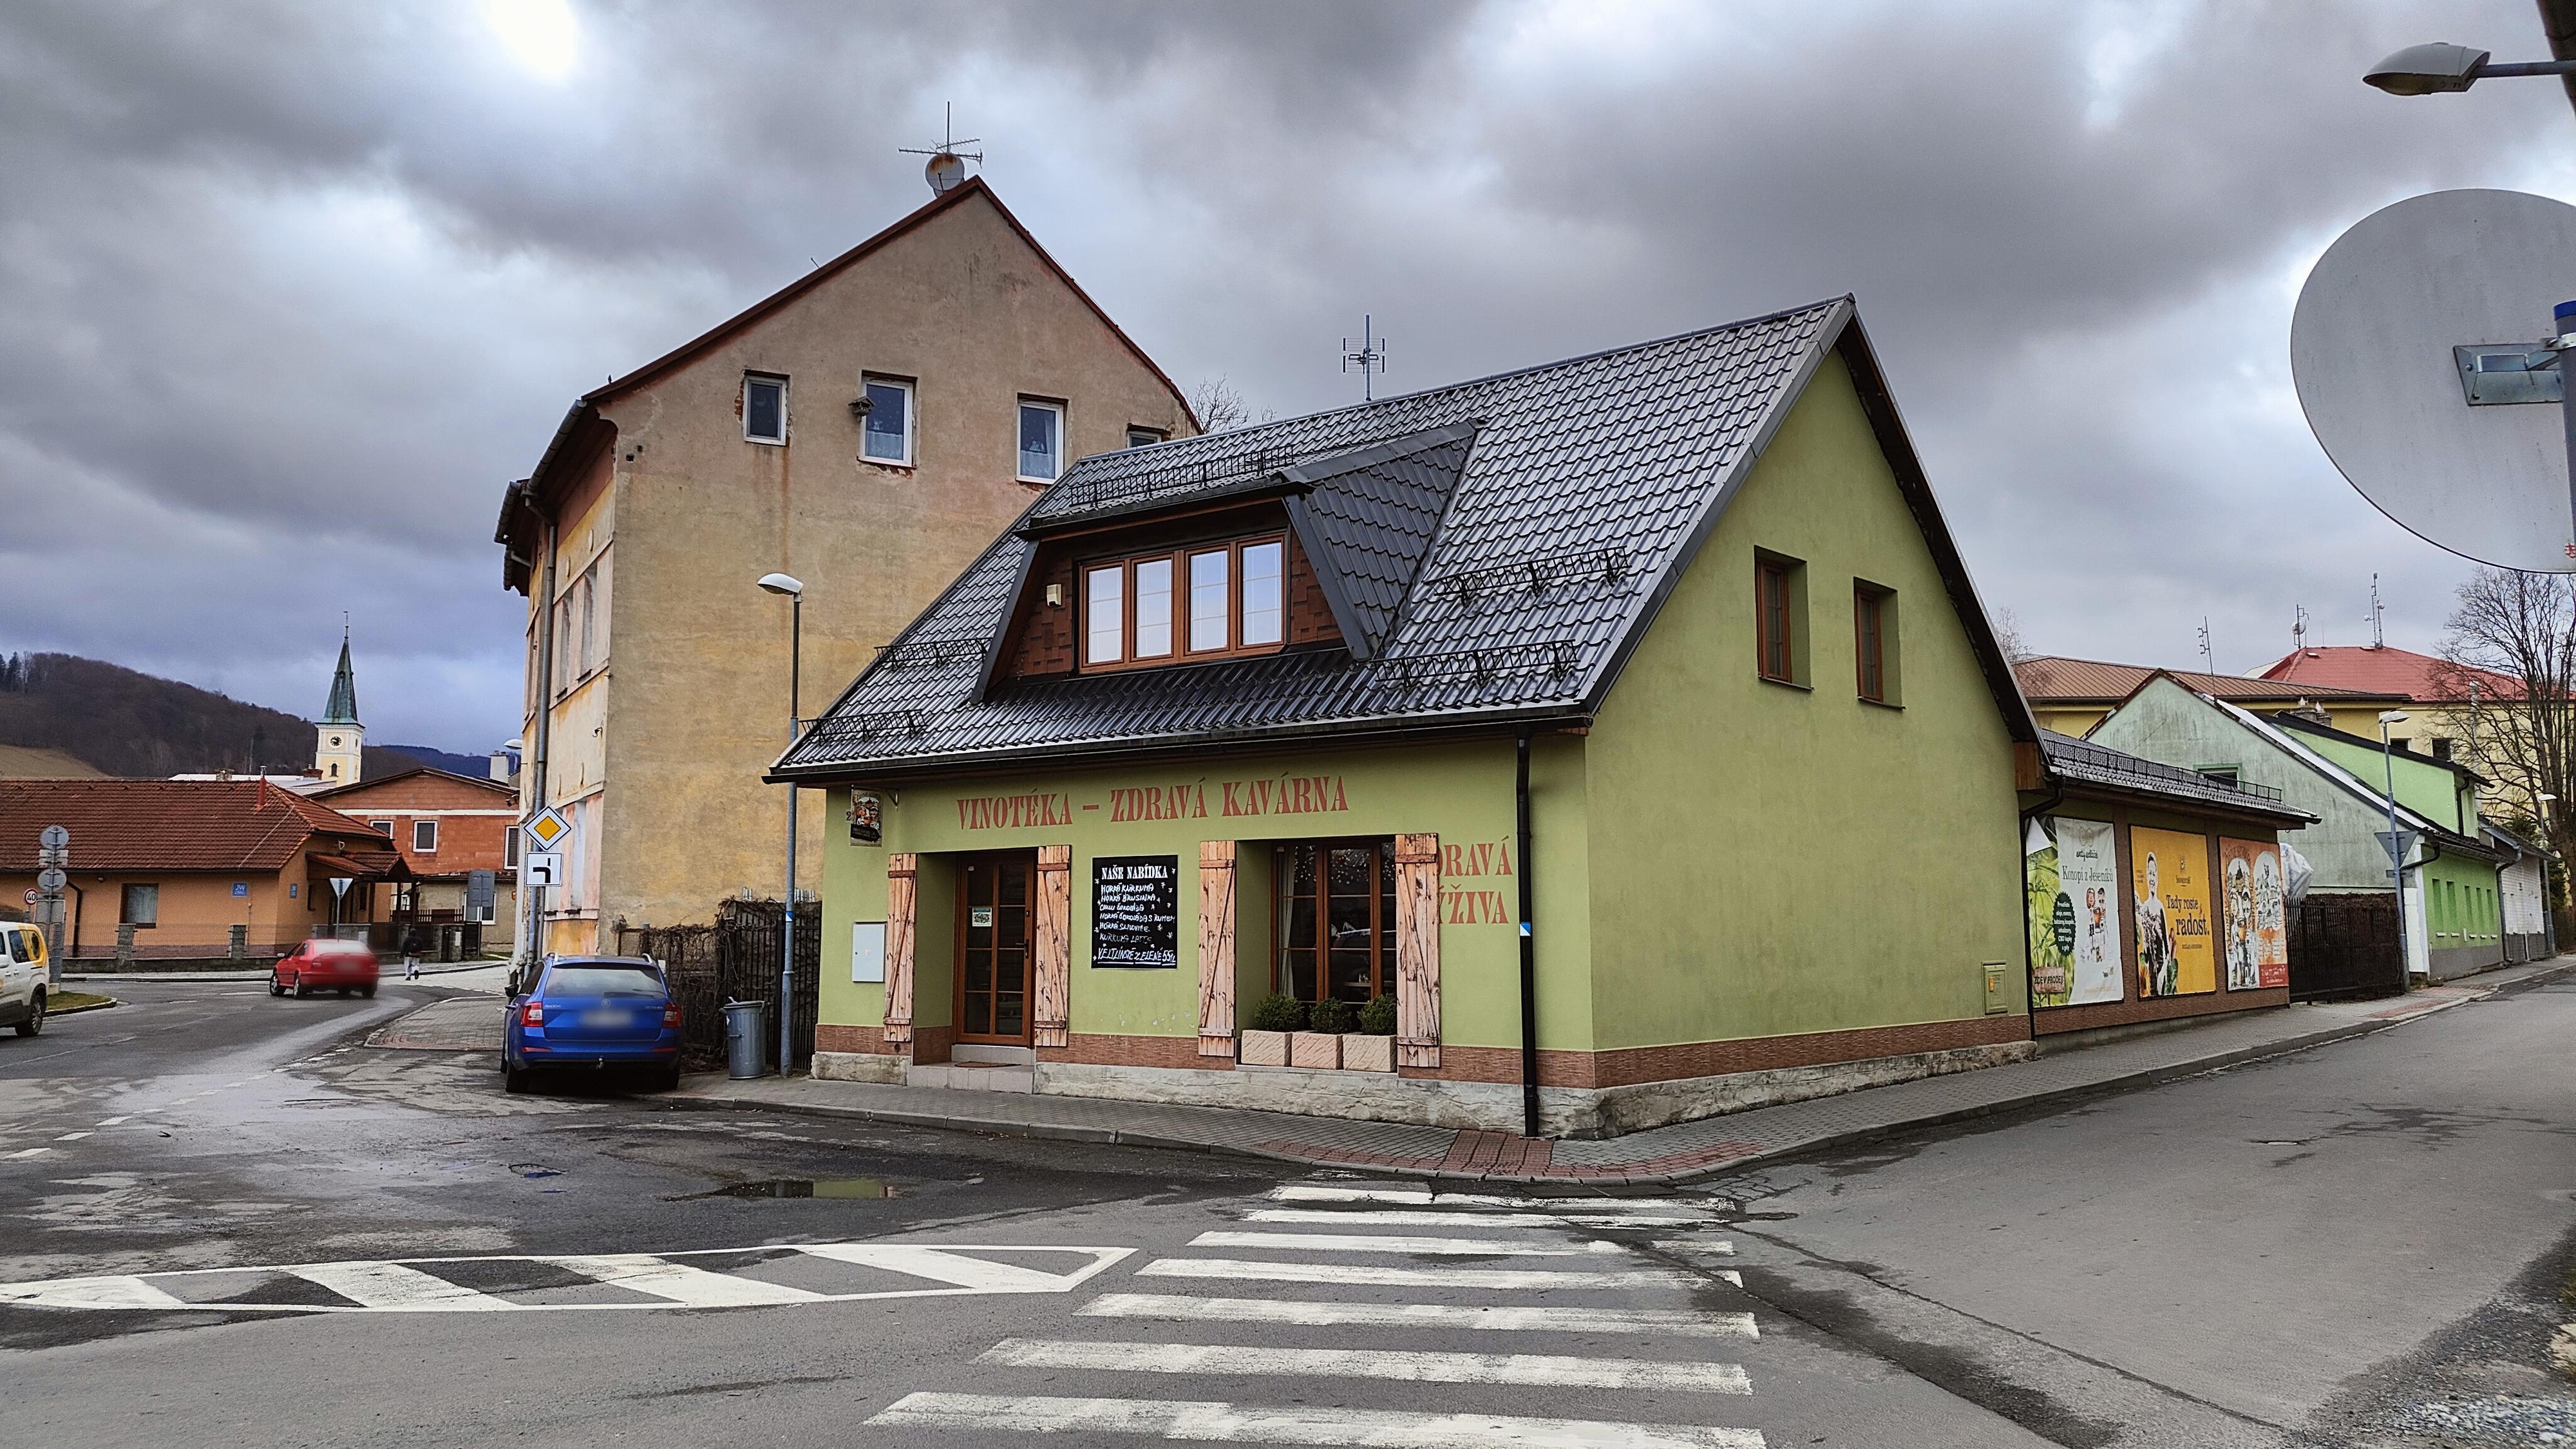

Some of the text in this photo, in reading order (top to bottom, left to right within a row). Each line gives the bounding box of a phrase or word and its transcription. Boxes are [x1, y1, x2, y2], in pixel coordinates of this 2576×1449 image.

[956, 788, 1073, 829] VINOTÉKA
[1110, 777, 1209, 822] ZDRAVÁ
[1221, 771, 1349, 817] KAVÁRNA
[1101, 864, 1168, 880] NAŠE NABÍDKA
[2062, 866, 2083, 884] Konopí
[2085, 871, 2088, 881] z
[1101, 882, 1154, 893] HORKÁ KURKUMA
[1101, 894, 1156, 902] HORKÁ BRUSINKA
[2166, 895, 2199, 912] Tady roste
[1099, 911, 1118, 920] HORKÁ
[1099, 922, 1119, 930] HORKÁ
[2175, 913, 2210, 936] radost.
[1099, 933, 1129, 943] KURKUMA
